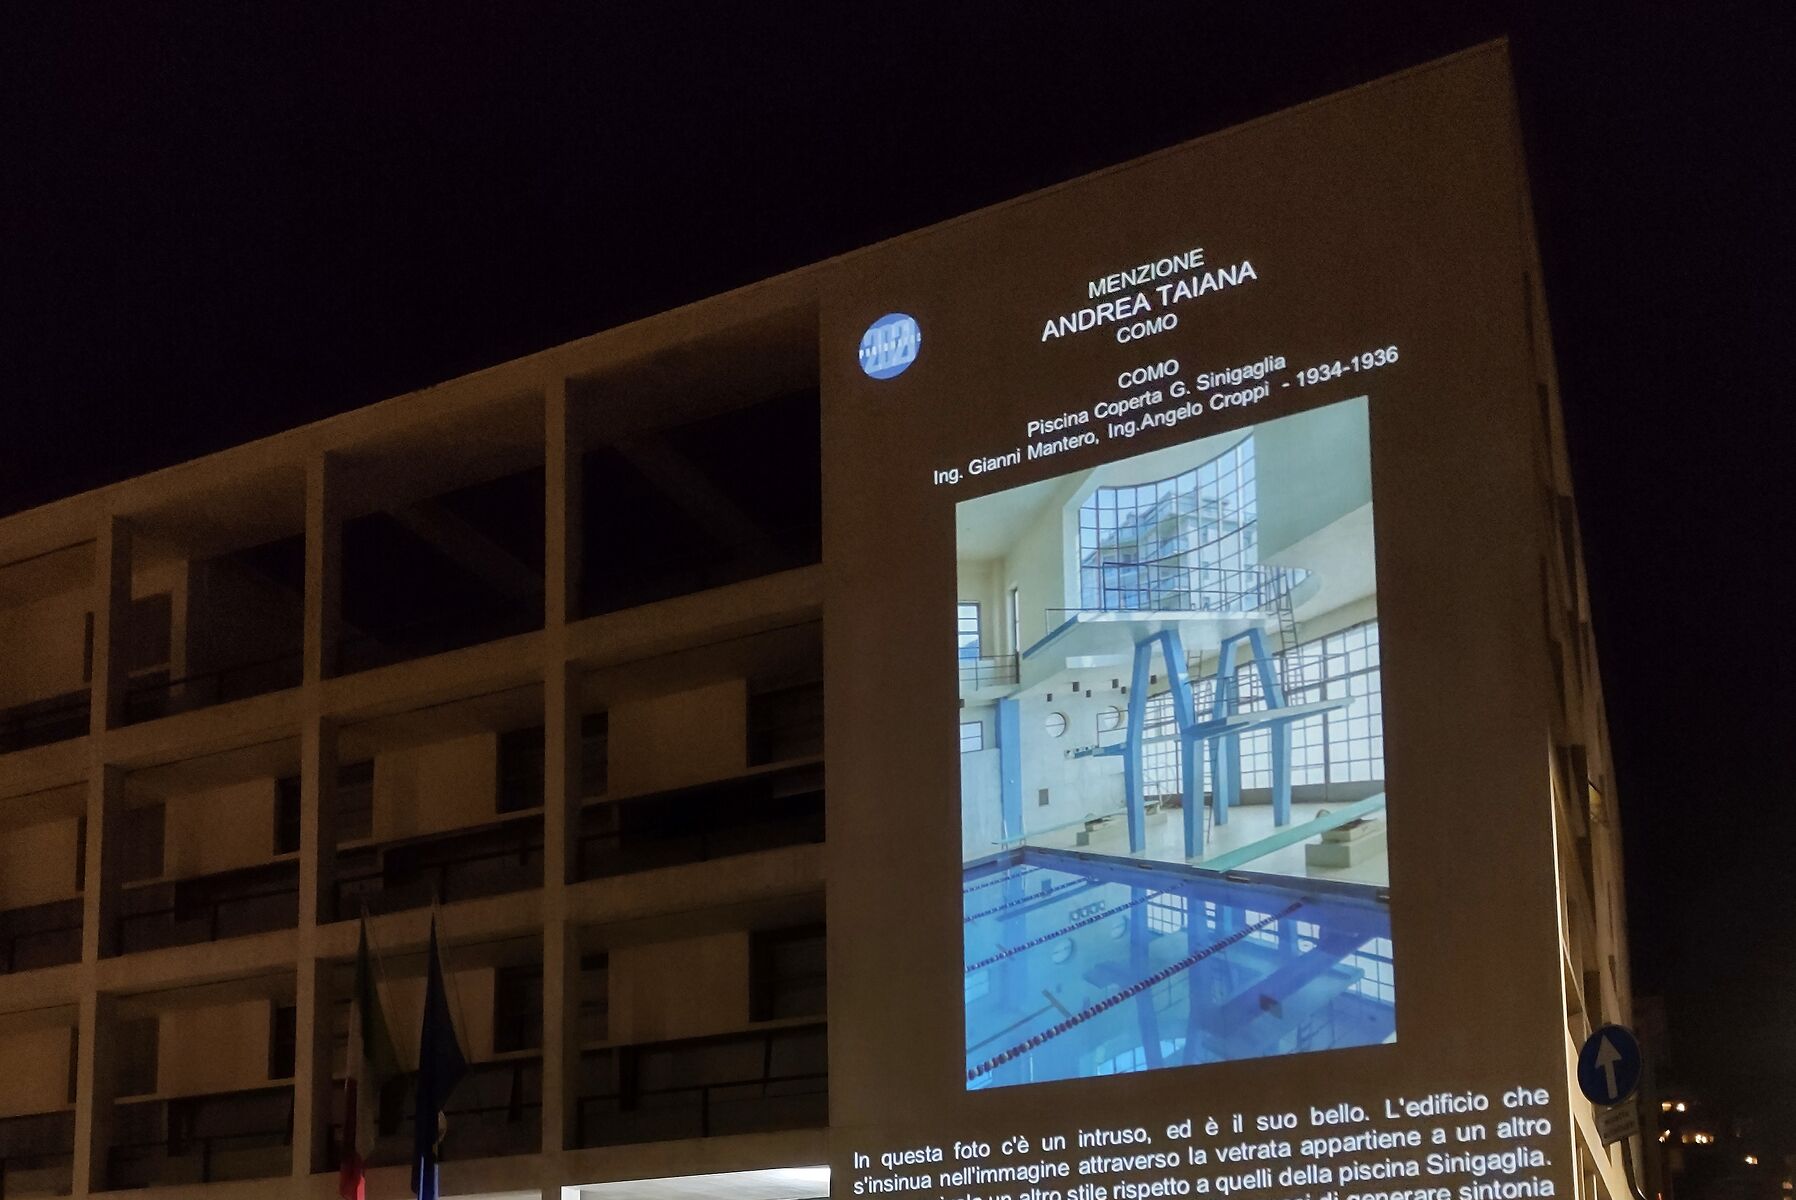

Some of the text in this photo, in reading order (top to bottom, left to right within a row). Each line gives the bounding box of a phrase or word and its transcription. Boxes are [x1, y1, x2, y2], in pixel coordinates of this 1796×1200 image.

[1041, 260, 1258, 342] ANDREA TAIANA
[1088, 247, 1205, 299] MENZIONE
[1116, 313, 1178, 344] COMO
[1027, 355, 1287, 438] Piscina Coperta G. Sinigaglia
[1117, 359, 1180, 389] COMO
[933, 465, 964, 487] Ing.
[968, 447, 1021, 471] Gianni
[1027, 431, 1100, 461] Mantero,
[1209, 380, 1270, 411] Croppi
[1296, 345, 1399, 387] 1934-1936
[853, 1116, 1552, 1195] s'insinua nell'immagine attraverso la vetrata appartiene a un altro
[854, 1085, 1550, 1171] In questa foto c'è un intruso, ed è il suo bello. L'edificio che
[1196, 1177, 1210, 1194] a
[1215, 1167, 1273, 1196] quelli
[1278, 1163, 1333, 1187] della
[1338, 1157, 1421, 1187] piscina
[1426, 1146, 1552, 1177] Sinigaglia.
